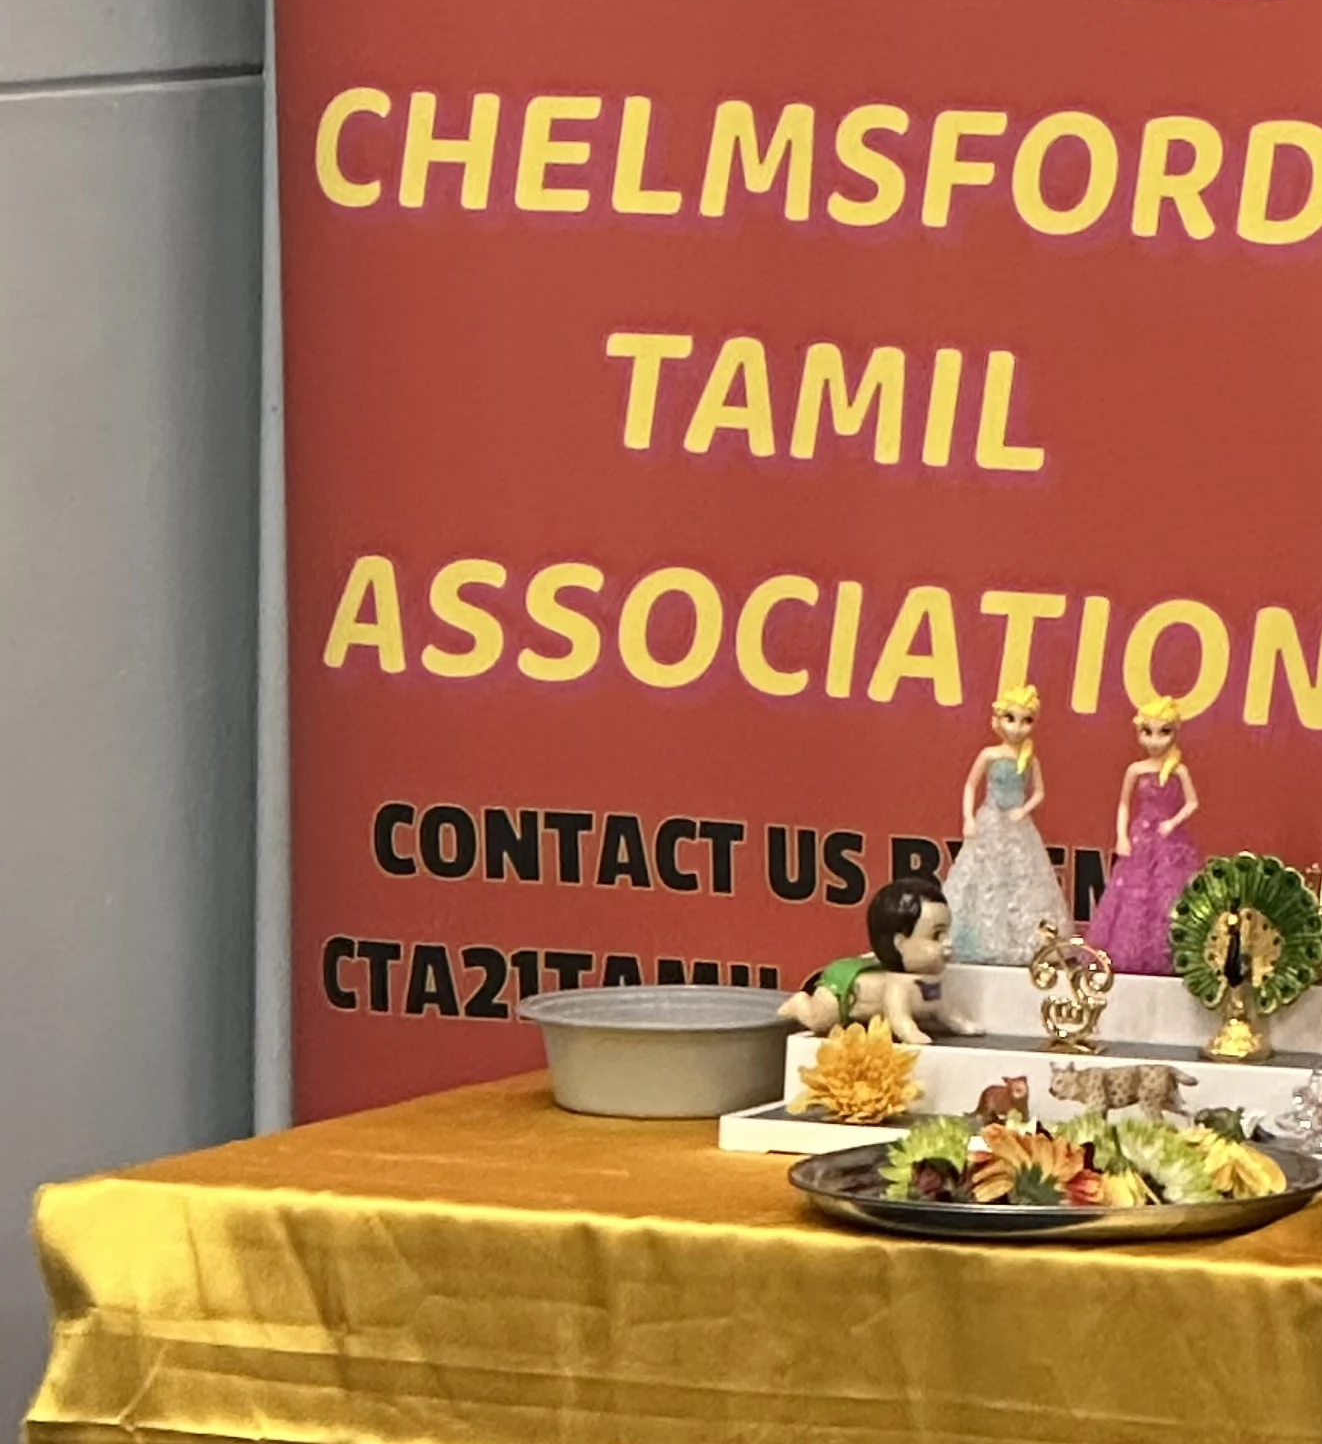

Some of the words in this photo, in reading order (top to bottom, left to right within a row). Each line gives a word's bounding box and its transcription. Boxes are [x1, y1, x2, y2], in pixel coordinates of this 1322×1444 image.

[606, 332, 1046, 472] TAMIL
[374, 802, 744, 896] CONTACT
[767, 826, 866, 906] US
